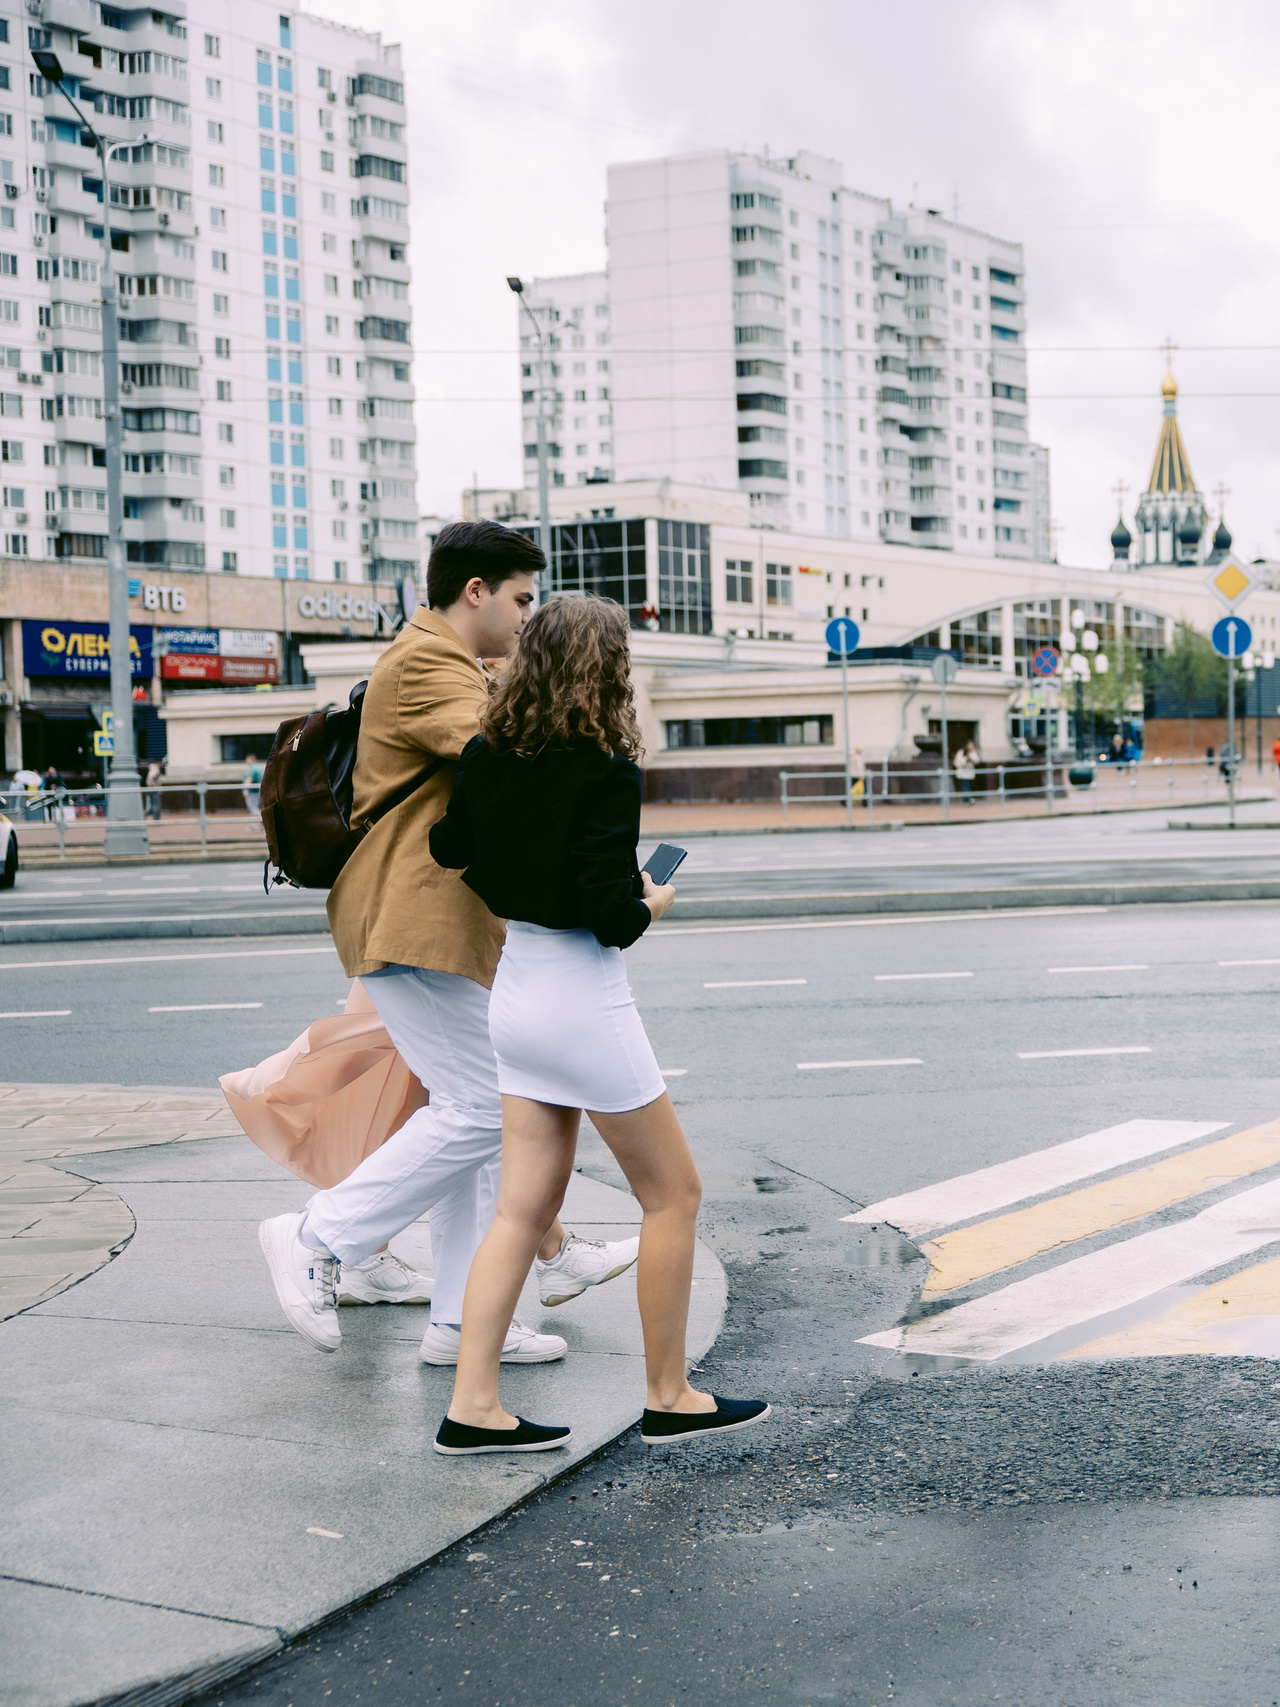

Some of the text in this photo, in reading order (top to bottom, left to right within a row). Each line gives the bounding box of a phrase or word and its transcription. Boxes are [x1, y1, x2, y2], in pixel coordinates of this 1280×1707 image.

[144, 585, 187, 612] ВТБ
[299, 590, 377, 621] adidas
[65, 658, 142, 673] СУПЕРМЕТ
